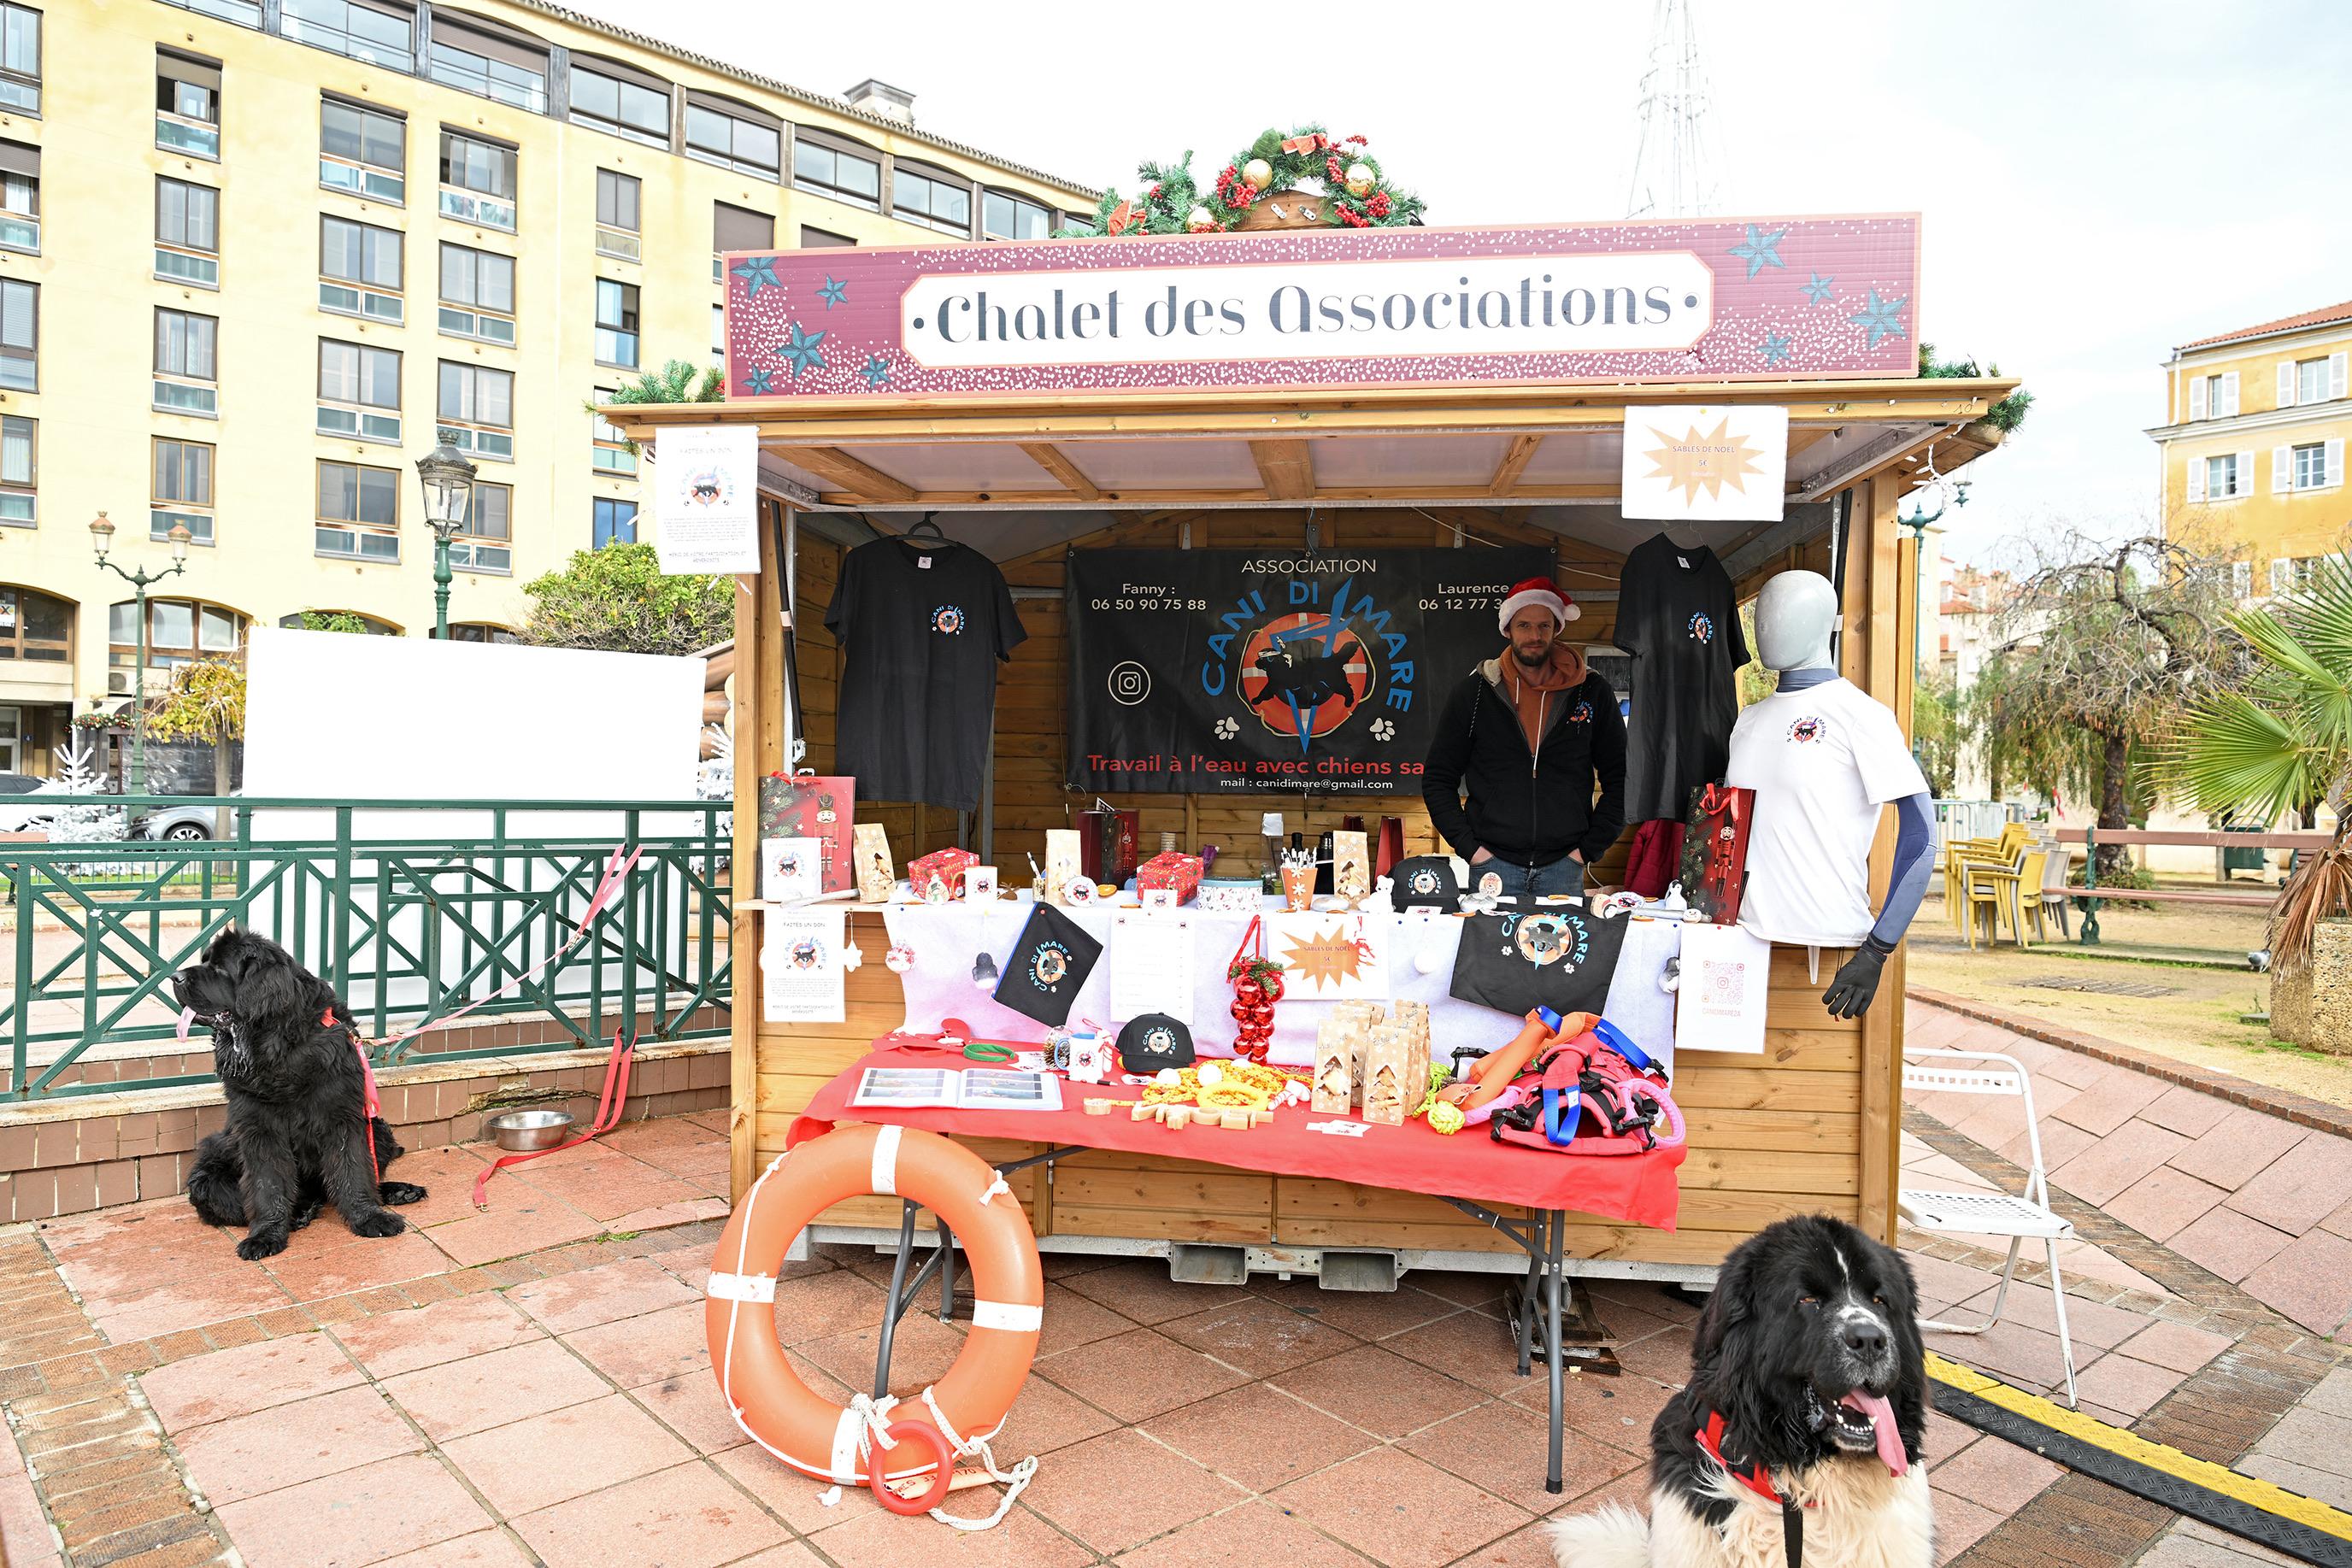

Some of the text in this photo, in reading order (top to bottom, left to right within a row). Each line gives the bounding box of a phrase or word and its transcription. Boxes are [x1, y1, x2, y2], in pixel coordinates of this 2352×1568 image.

[939, 273, 1671, 343] Chalet des Associations
[1241, 559, 1376, 574] ASSOCIATION
[1122, 583, 1167, 597] Fanny
[1438, 583, 1510, 595] Laurence
[931, 605, 944, 623] CANI
[1091, 598, 1207, 611] 06 50 90 75 88
[1418, 599, 1439, 610] 06
[1444, 598, 1463, 610] 12
[1468, 598, 1488, 609] 77
[1704, 617, 1714, 640] MARE
[1202, 581, 1414, 713] CANI DI MARE
[1087, 754, 1161, 772] Travail
[1169, 755, 1182, 772] à
[1255, 760, 1309, 774] avec
[1316, 756, 1392, 775] chiens
[1220, 778, 1245, 787] mail
[1255, 778, 1394, 790] canidimare@gmail.com
[1408, 871, 1419, 889] CANI
[1430, 870, 1442, 890] MARE
[1501, 913, 1590, 965] CA MARE
[784, 937, 797, 960] CANI
[814, 938, 826, 964] MARE
[1028, 941, 1069, 991] CANI DI MARE
[1702, 1007, 1742, 1018] CANIDIMARE2A
[1143, 1027, 1155, 1046] CANI
[1167, 1030, 1177, 1051] MARE
